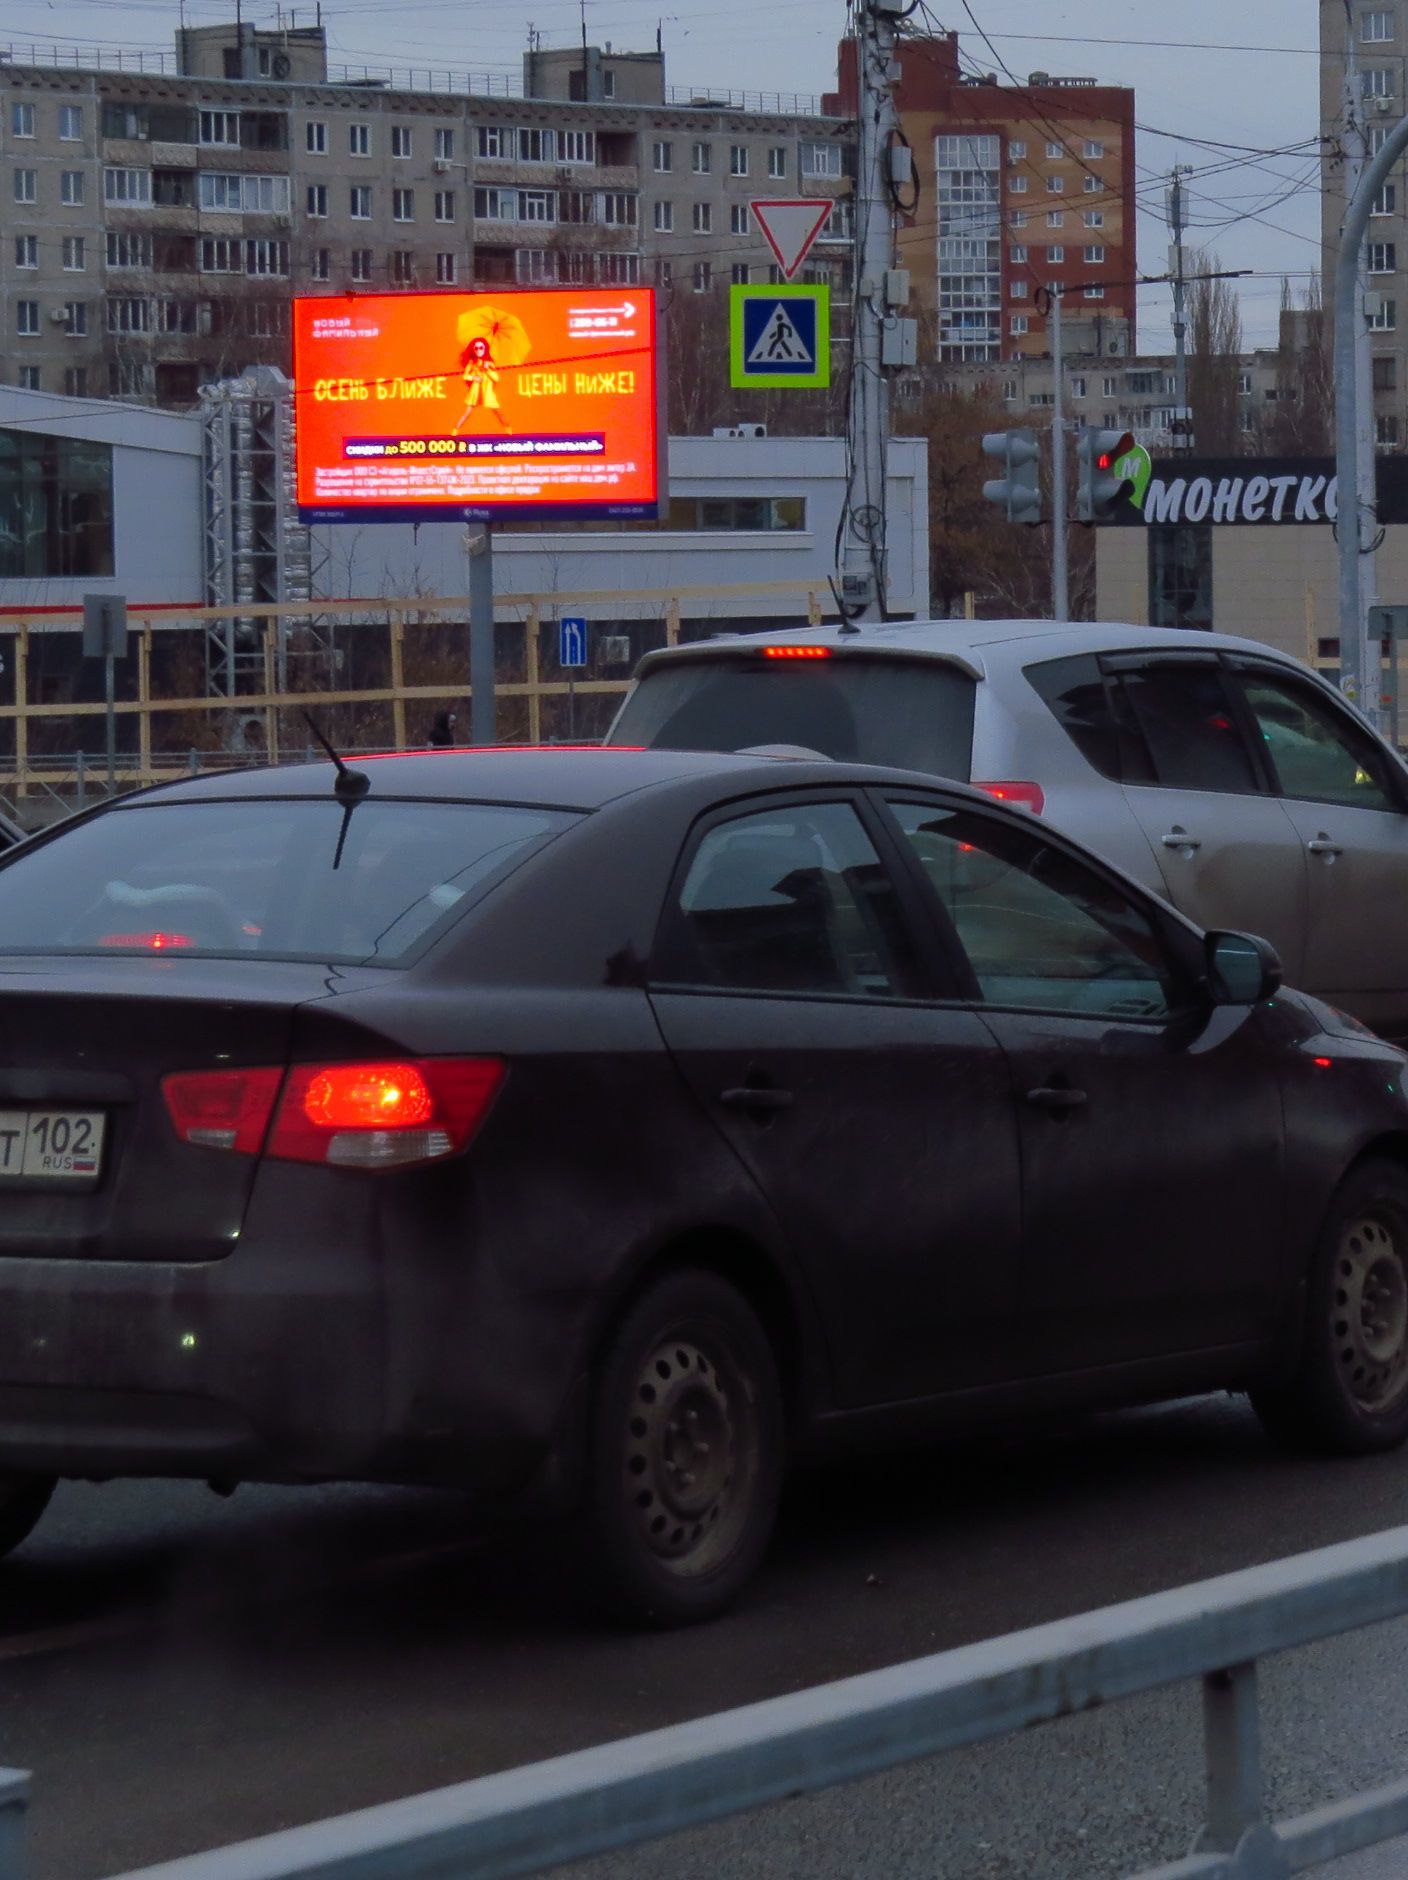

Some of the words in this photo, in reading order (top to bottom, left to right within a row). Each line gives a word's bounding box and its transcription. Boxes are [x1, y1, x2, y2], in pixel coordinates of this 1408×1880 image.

[314, 377, 369, 401] ОСЕНЬ
[376, 376, 447, 400] БЛИЖЕ
[518, 372, 567, 398] ЦЕНЫ
[576, 371, 635, 394] НИЖЕ!
[399, 440, 426, 454] 500
[428, 440, 456, 454] 000
[32, 1116, 92, 1155] 102
[42, 1155, 72, 1169] RUS
